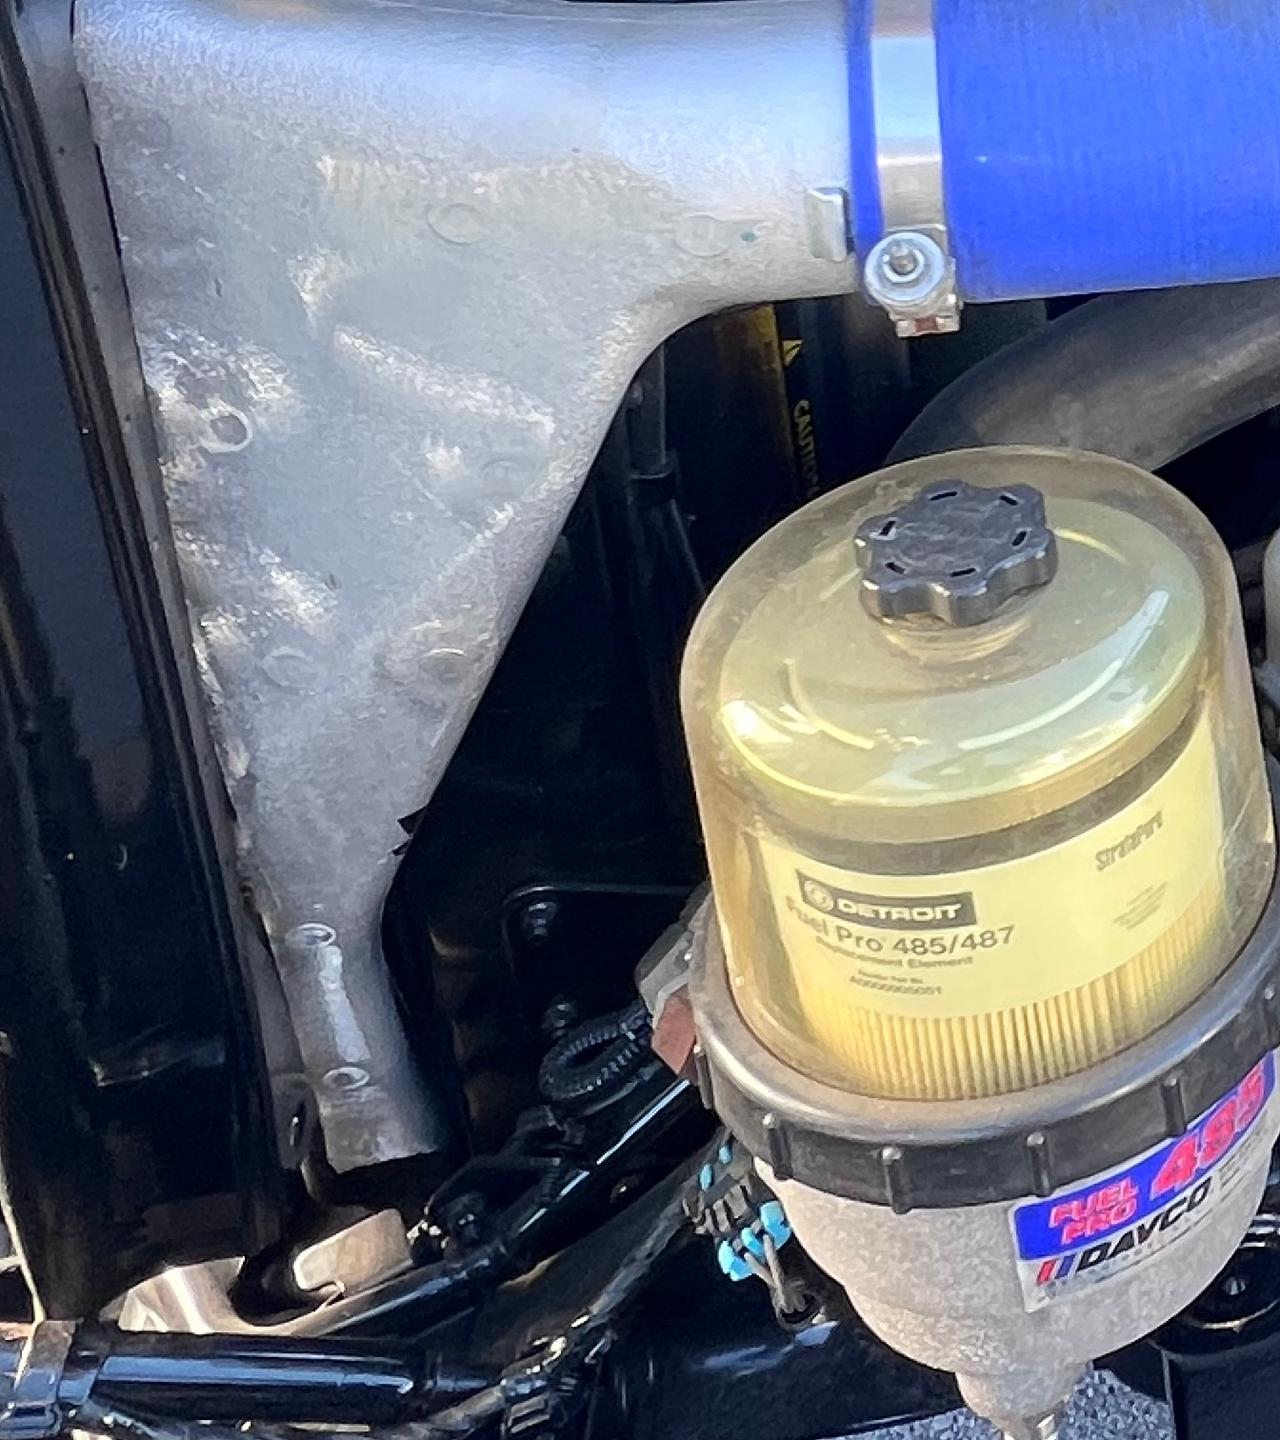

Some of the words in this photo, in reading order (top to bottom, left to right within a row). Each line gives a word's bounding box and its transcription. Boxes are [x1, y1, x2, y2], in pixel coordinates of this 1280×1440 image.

[837, 897, 962, 923] DETROIT
[836, 925, 884, 953] Pro
[893, 924, 1015, 957] 485/487
[1049, 1178, 1140, 1228] FUEL
[1062, 1198, 1138, 1246] PRO
[1077, 1176, 1213, 1273] DAVCO
